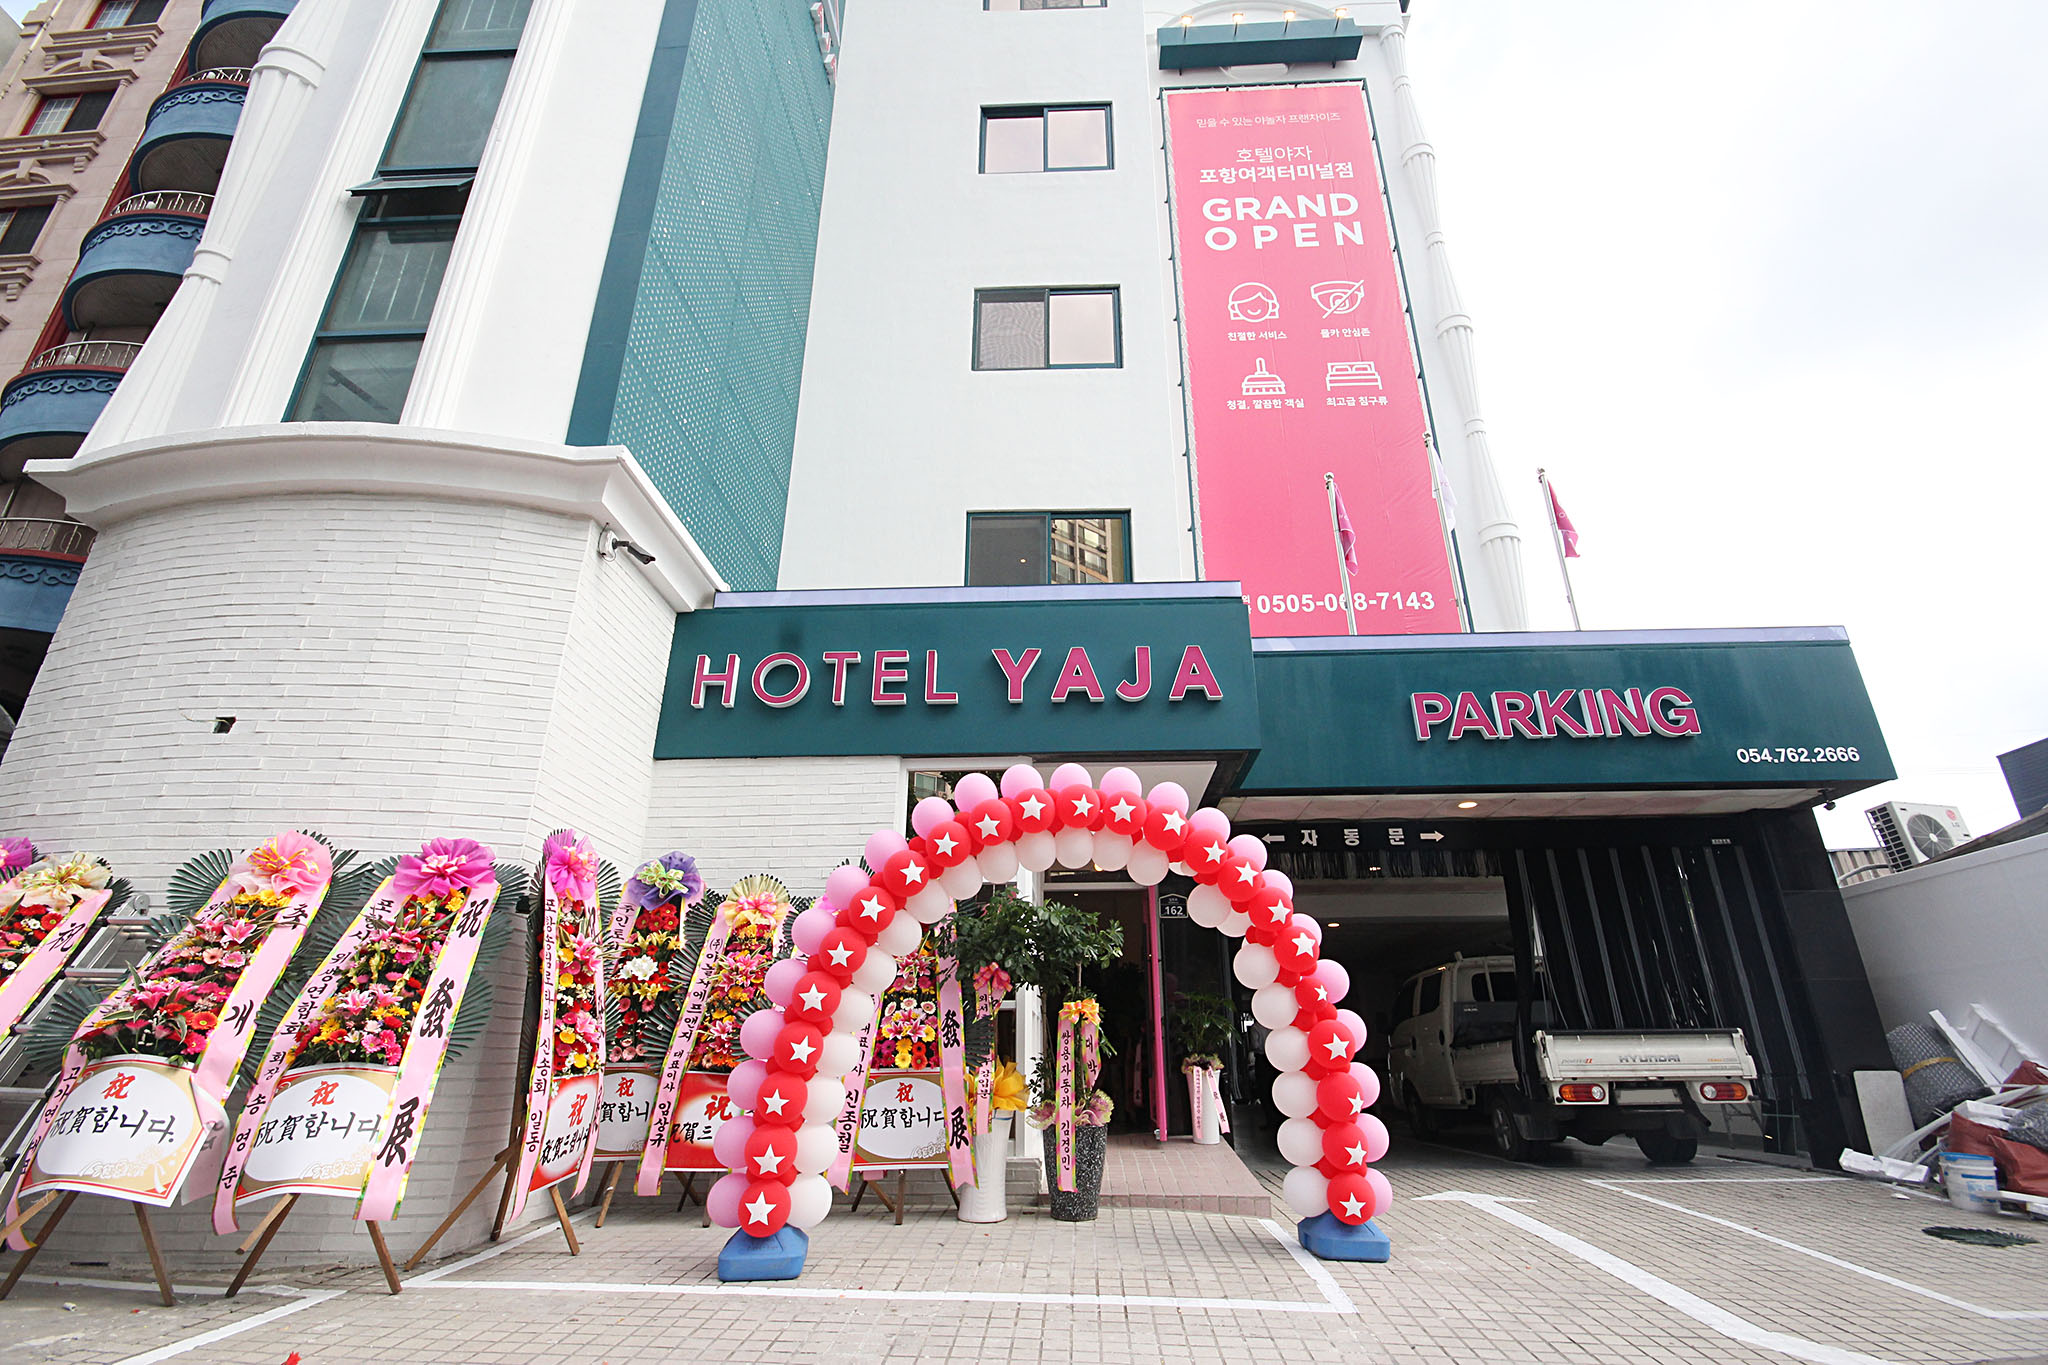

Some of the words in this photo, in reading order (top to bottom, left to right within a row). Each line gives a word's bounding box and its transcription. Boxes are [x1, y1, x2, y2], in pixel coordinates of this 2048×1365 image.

[1196, 118, 1217, 128] 믿을
[1219, 118, 1230, 127] 수
[1232, 117, 1252, 127] 있는
[1254, 114, 1286, 125] 야놀자
[1236, 145, 1312, 163] 호텔야자
[1199, 162, 1354, 184] 포항여객터미널점
[1202, 193, 1359, 222] GRAND
[1204, 221, 1364, 251] OPEN
[1227, 331, 1256, 341] 친절한
[1258, 330, 1288, 340] 서비스
[1343, 328, 1371, 337] 안심존
[1252, 398, 1282, 409] 깔끔한
[1284, 398, 1305, 408] 객실
[1326, 396, 1356, 407] 최고급
[1359, 396, 1389, 406] 침구류
[690, 649, 958, 709] HOTEL
[991, 645, 1223, 704] YAJA
[1411, 687, 1701, 741] PARKING
[1736, 746, 1860, 763] 054.762.2666
[1164, 906, 1183, 915] 162
[264, 1051, 286, 1081] 회장
[1085, 1034, 1097, 1075] 대박
[1619, 1054, 1681, 1064] HYUNDAI
[663, 1049, 684, 1092] 대표이사
[1060, 1030, 1072, 1108] 쌍용자동차
[102, 1072, 135, 1099] 祝
[307, 1081, 339, 1107] 祝
[616, 1076, 635, 1098] 祝
[895, 1082, 914, 1102] 祝
[568, 1092, 588, 1128] 祝
[601, 1101, 649, 1122] 賀합니
[704, 1094, 733, 1121] 祝
[526, 1110, 543, 1152] 일동
[650, 1101, 672, 1147] 임상규
[1060, 1122, 1071, 1170] 김경민
